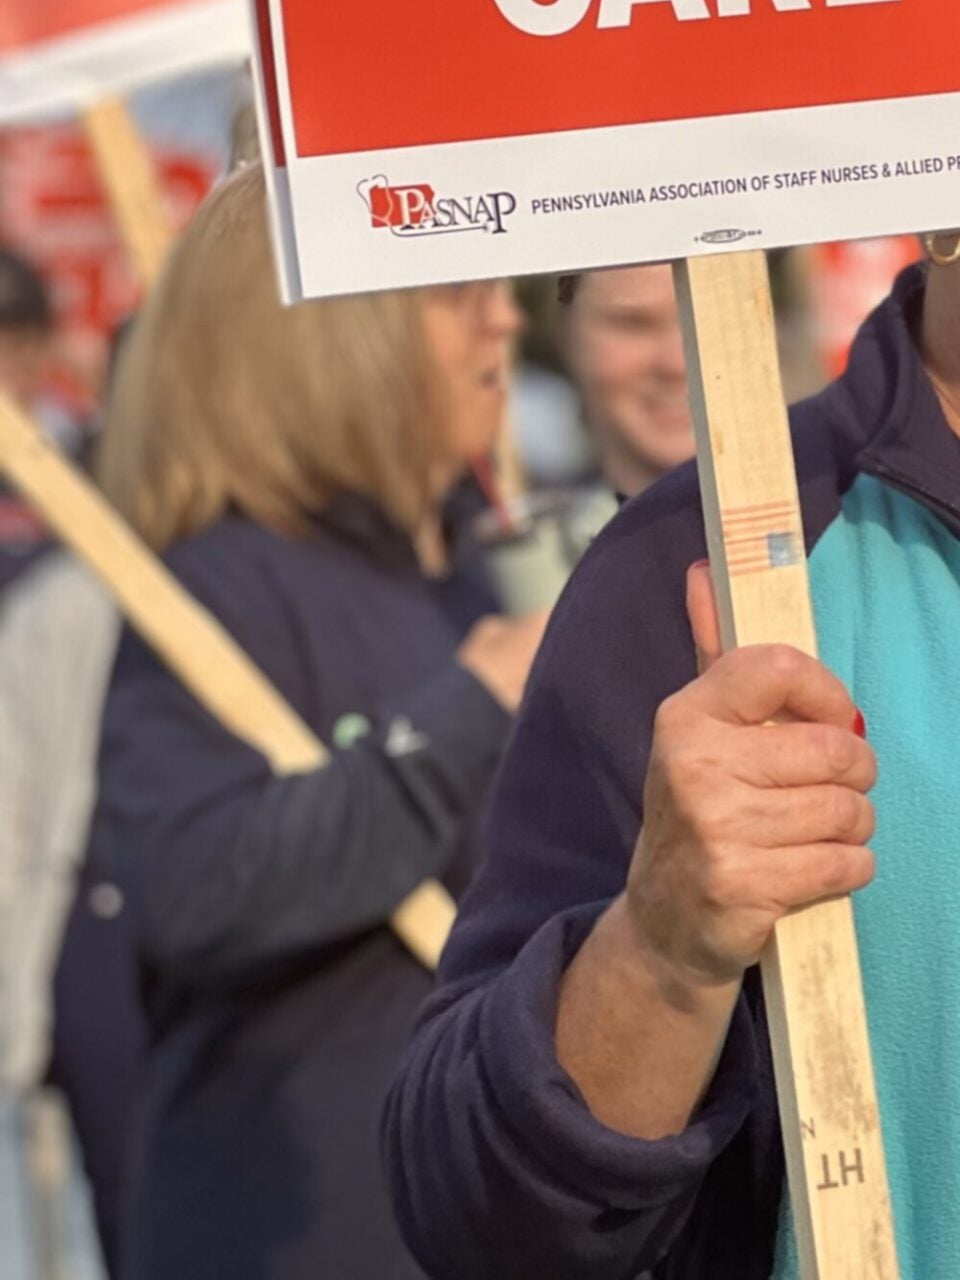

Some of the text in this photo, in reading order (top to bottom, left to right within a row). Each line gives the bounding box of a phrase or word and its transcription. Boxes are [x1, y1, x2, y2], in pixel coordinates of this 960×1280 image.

[394, 187, 517, 234] PASNAP
[531, 189, 646, 214] PENNSYLVANIA
[649, 178, 747, 202] ASSOCIATION
[751, 175, 770, 191] OF
[774, 170, 817, 189] STAFF
[820, 164, 878, 185] NURSES
[882, 163, 891, 177] &
[895, 157, 943, 176] ALLIED
